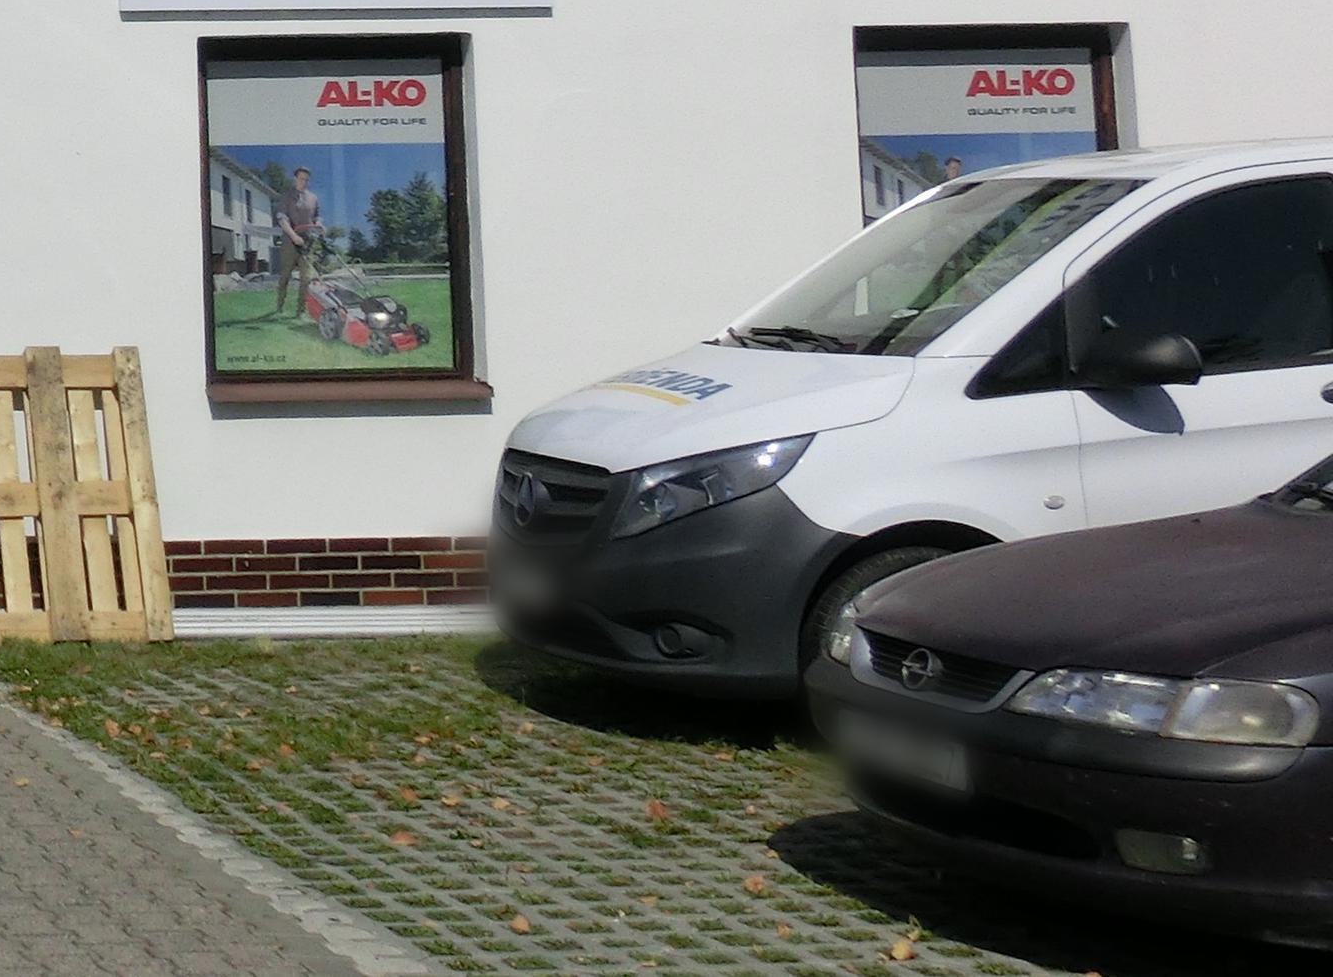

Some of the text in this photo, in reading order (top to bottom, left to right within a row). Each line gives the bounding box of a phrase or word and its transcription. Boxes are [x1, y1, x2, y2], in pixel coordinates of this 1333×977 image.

[966, 68, 1075, 97] AL-KO
[316, 79, 427, 108] AL-KO
[967, 106, 1076, 116] QUALITY FOR LIFE
[317, 117, 427, 127] QUALITY FOR LIFE
